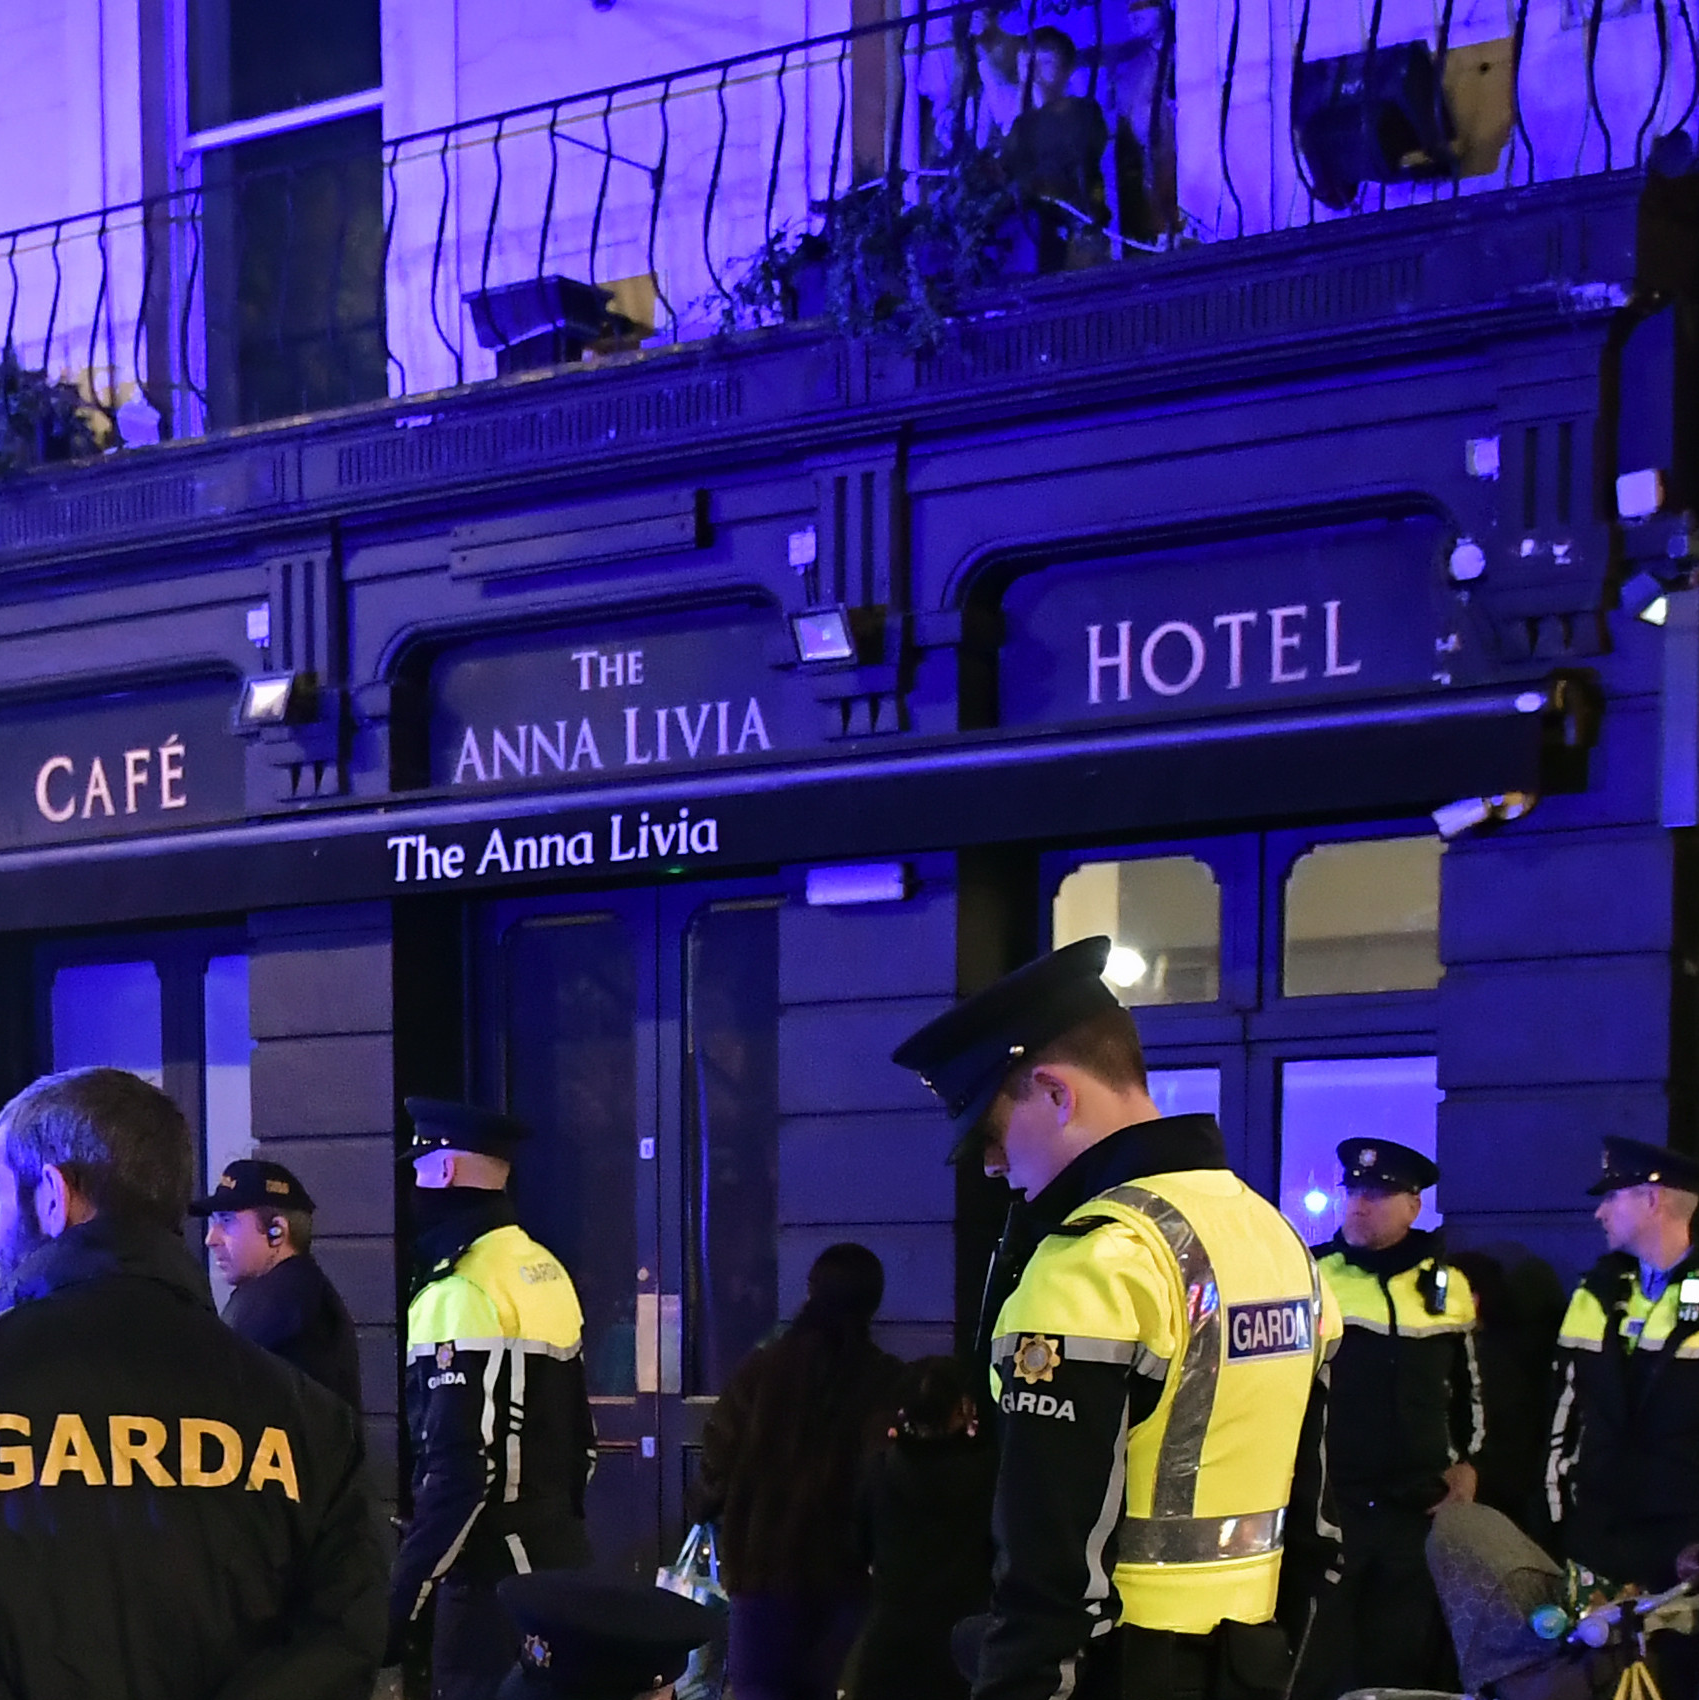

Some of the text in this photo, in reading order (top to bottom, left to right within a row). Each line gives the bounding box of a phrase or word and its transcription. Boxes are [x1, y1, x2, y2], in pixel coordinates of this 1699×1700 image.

[572, 650, 644, 690] THE
[1086, 600, 1362, 705] HOTEL
[36, 733, 188, 822] CAFÉ
[452, 697, 774, 785] ANNA LIVIA
[387, 807, 718, 883] The Anna Livia
[1232, 1298, 1310, 1351] GARDA
